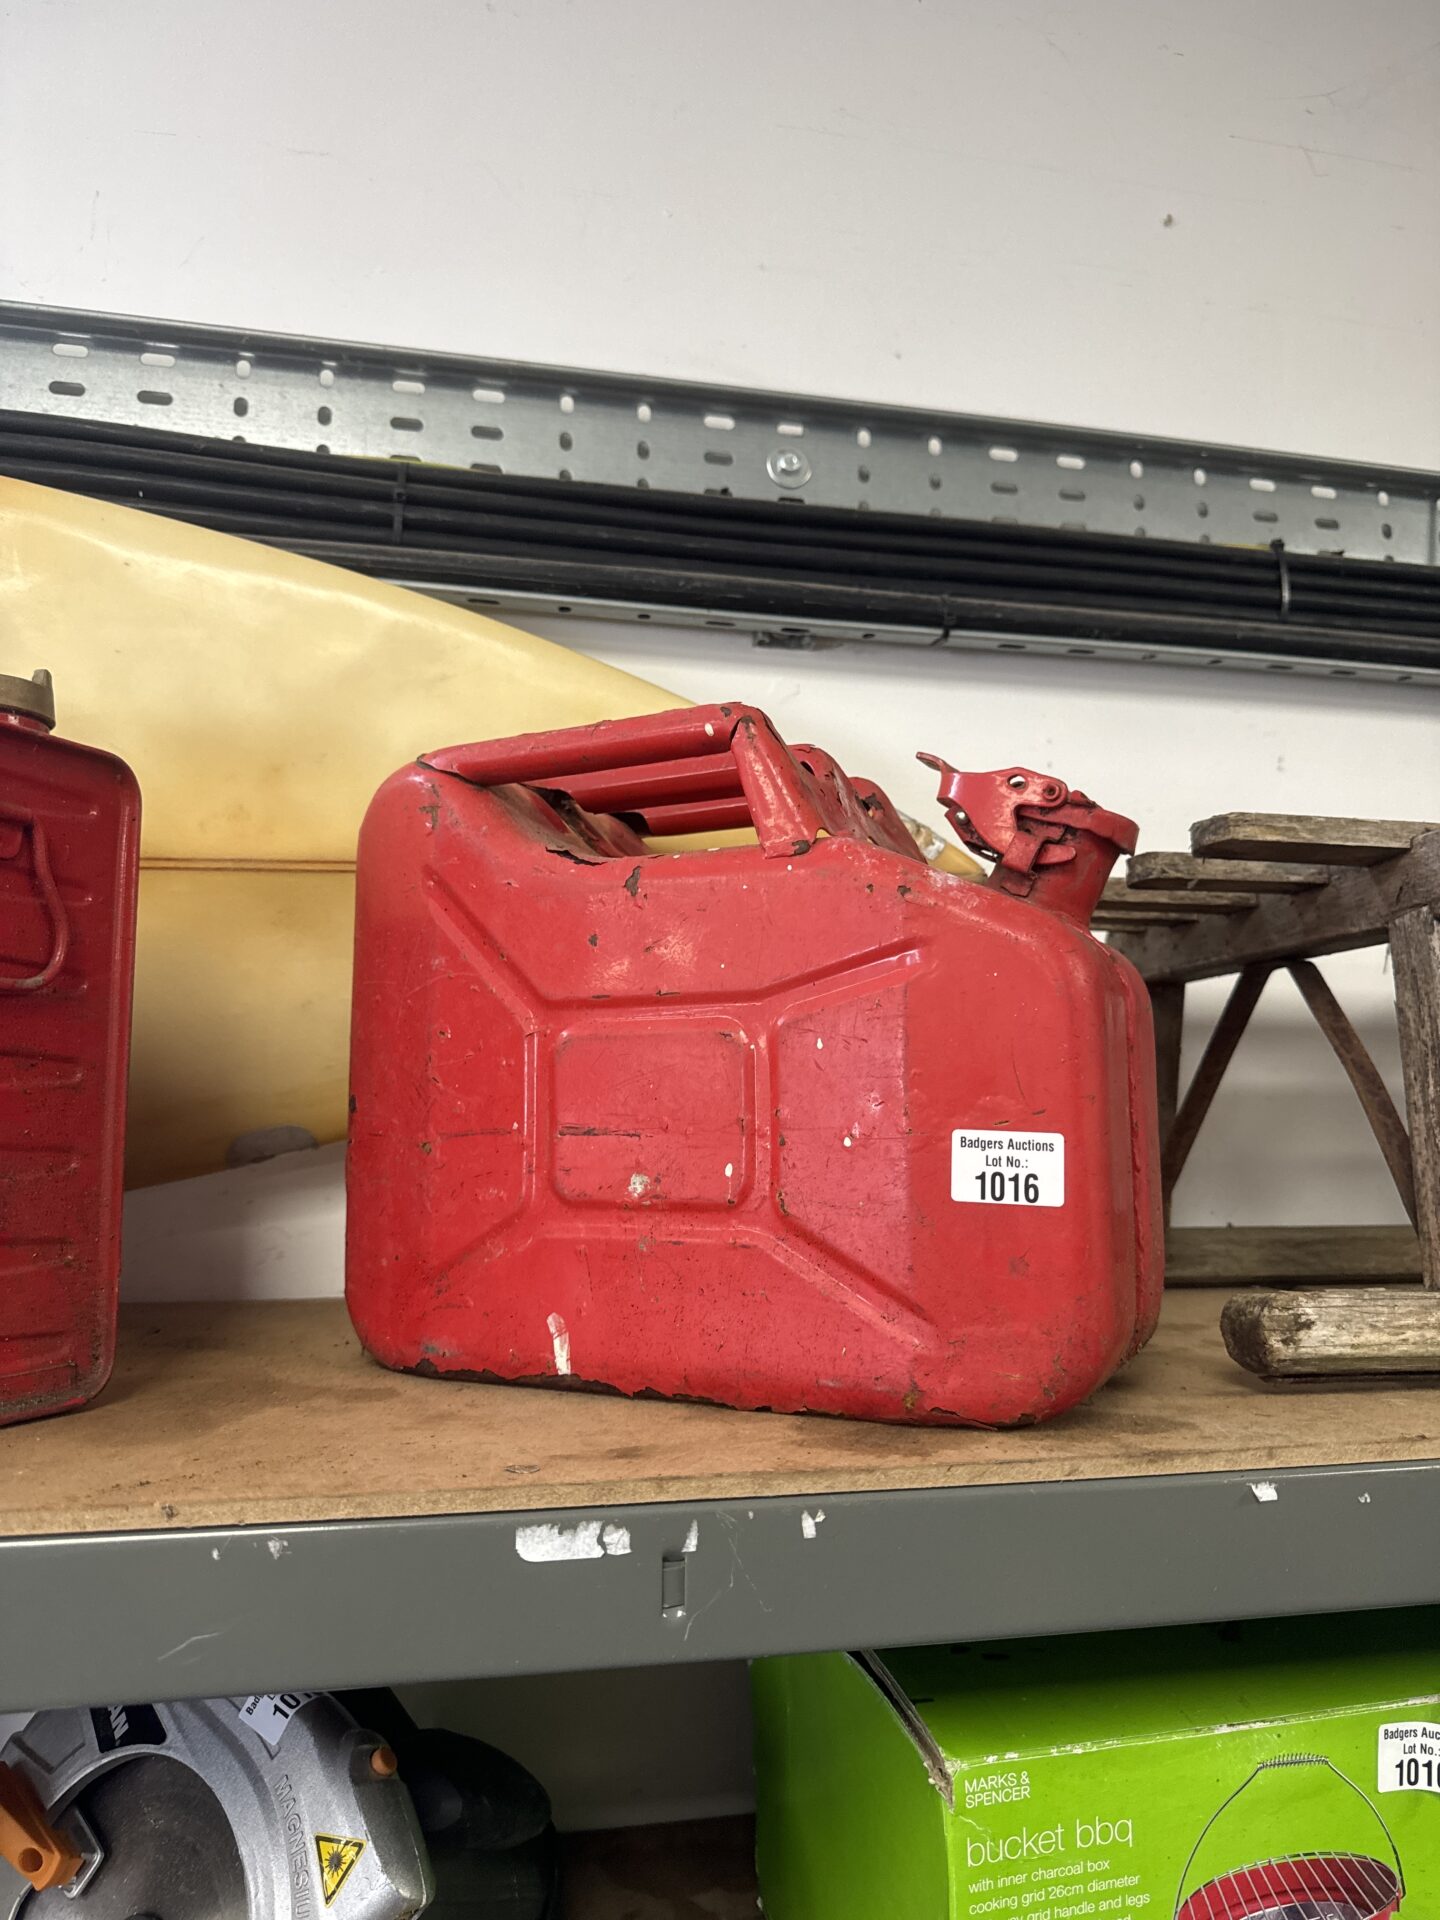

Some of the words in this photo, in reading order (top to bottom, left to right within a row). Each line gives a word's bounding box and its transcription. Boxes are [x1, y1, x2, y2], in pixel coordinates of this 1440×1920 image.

[960, 1136, 1004, 1151] Badgers
[1007, 1138, 1055, 1152] Auctions
[985, 1154, 1002, 1167] Lot
[1006, 1155, 1029, 1169] No.:
[974, 1171, 1040, 1204] 1016
[245, 1694, 264, 1716] Bad
[272, 1693, 313, 1720] 10
[1383, 1728, 1418, 1741] Badgers
[1403, 1743, 1417, 1755] Lot
[964, 1772, 1018, 1794] MARKS
[1020, 1770, 1031, 1785] &
[965, 1785, 1031, 1809] SPENCER
[966, 1823, 1065, 1867] bucket
[1076, 1815, 1133, 1848] bbq
[968, 1878, 994, 1894] with
[997, 1871, 1028, 1888] inner
[1031, 1861, 1084, 1881] charcoal
[1087, 1858, 1110, 1873] box
[968, 1895, 1018, 1915] cooking
[1021, 1888, 1046, 1907] grid
[1048, 1884, 1084, 1899] 26cm
[1087, 1874, 1141, 1892] diameter
[1054, 1901, 1096, 1919] handle
[1098, 1895, 1122, 1911] and
[1125, 1893, 1151, 1908] legs
